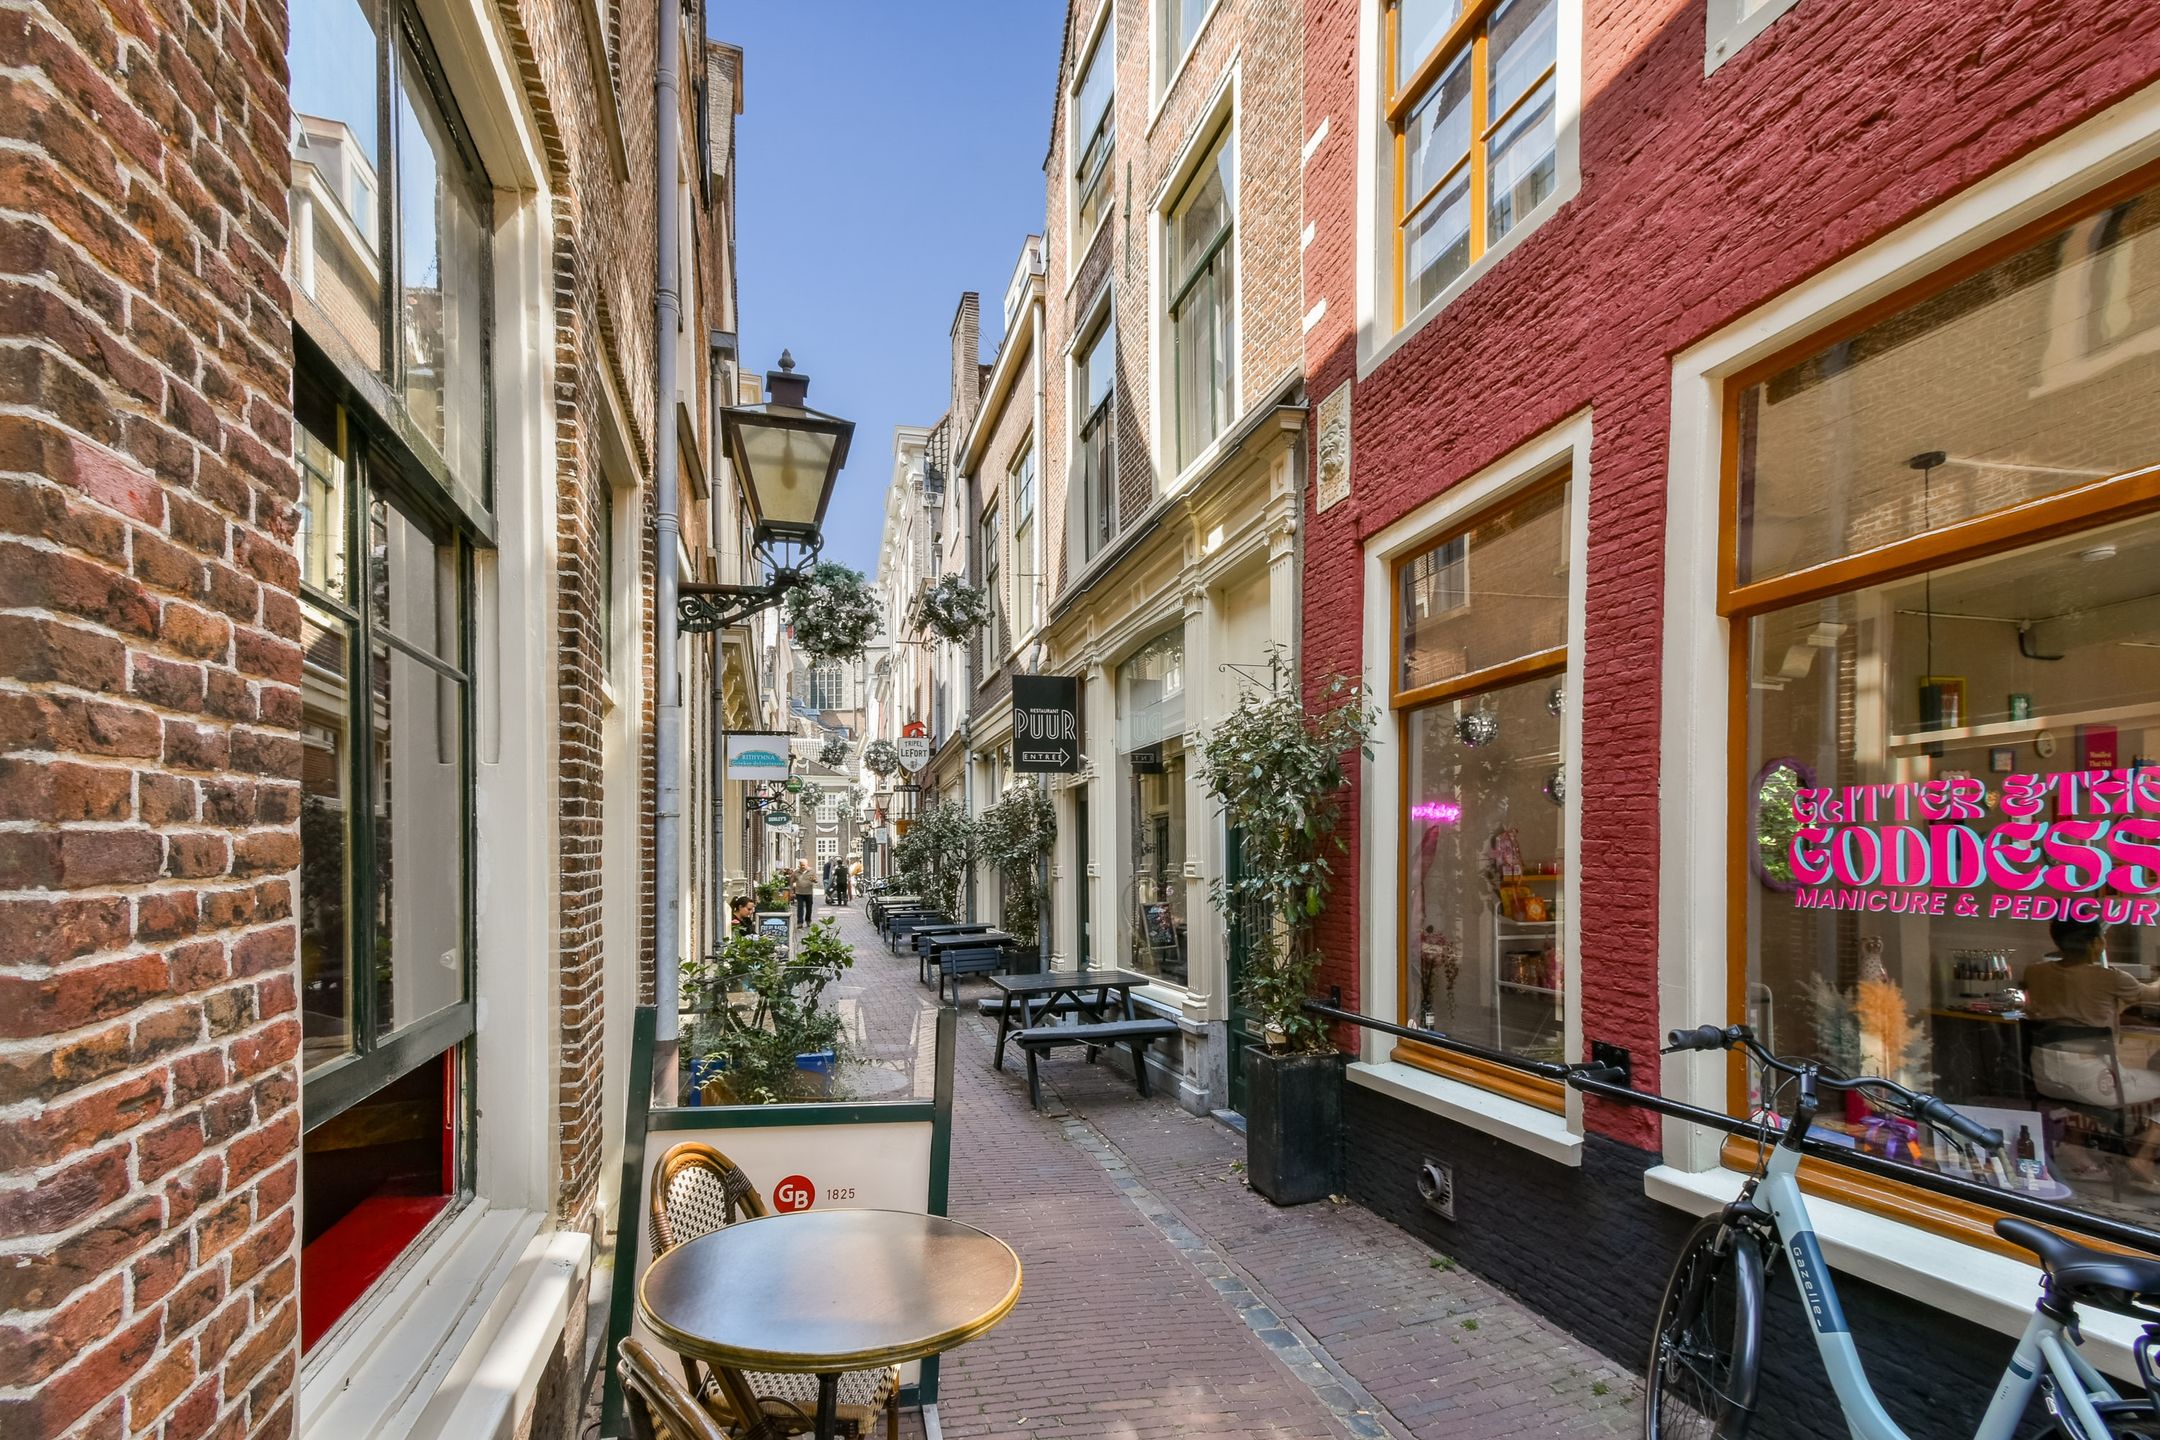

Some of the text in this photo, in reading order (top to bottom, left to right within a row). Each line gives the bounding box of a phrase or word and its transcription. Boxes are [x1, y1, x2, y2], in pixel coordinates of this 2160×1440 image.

[1014, 708, 1076, 740] PUUR
[904, 740, 923, 748] TRIPEL
[1791, 779, 1986, 824] GLITTER
[2001, 773, 2047, 817] &
[1789, 819, 2160, 895] GODDESS
[1795, 888, 1948, 915] MANICURE
[1953, 893, 1979, 917] &
[778, 1184, 855, 1209] GB 1825
[1792, 1246, 1822, 1314] Gazelle
